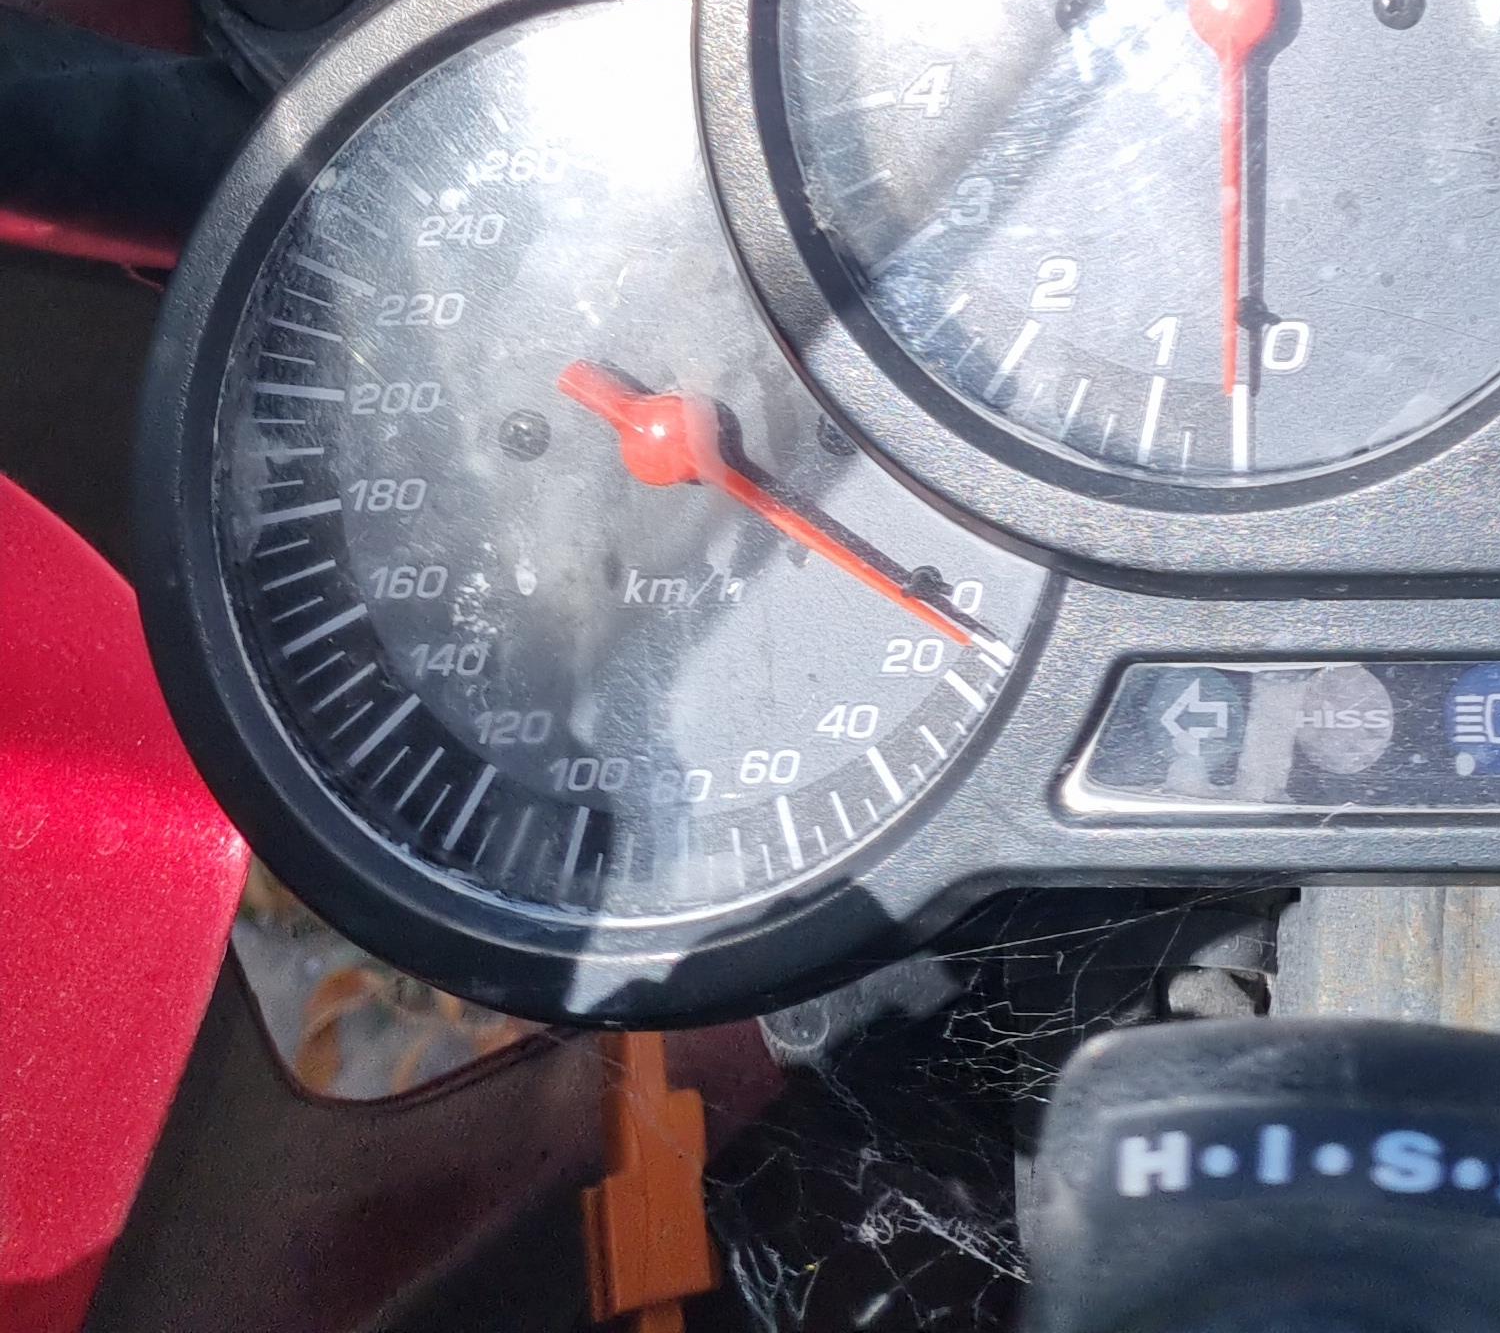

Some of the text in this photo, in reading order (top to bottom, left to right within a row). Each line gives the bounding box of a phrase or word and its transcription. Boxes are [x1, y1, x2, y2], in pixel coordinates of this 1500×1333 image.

[902, 62, 955, 118] 4
[478, 148, 567, 184] 260
[949, 176, 995, 226] 3
[416, 212, 504, 248] 240
[1029, 258, 1080, 309] 2
[375, 292, 466, 328] 220
[1144, 316, 1182, 366] 1
[1262, 321, 1309, 370] 0
[351, 382, 441, 415] 200
[348, 477, 428, 512] 180
[369, 565, 449, 600] 160
[623, 568, 745, 607] km/h
[951, 580, 983, 614] 0
[410, 643, 492, 677] 140
[880, 638, 945, 675] 20
[474, 709, 554, 745] 120
[815, 704, 879, 739] 40
[1295, 709, 1392, 730] HISS
[549, 757, 630, 791] 100
[739, 749, 801, 784] 60
